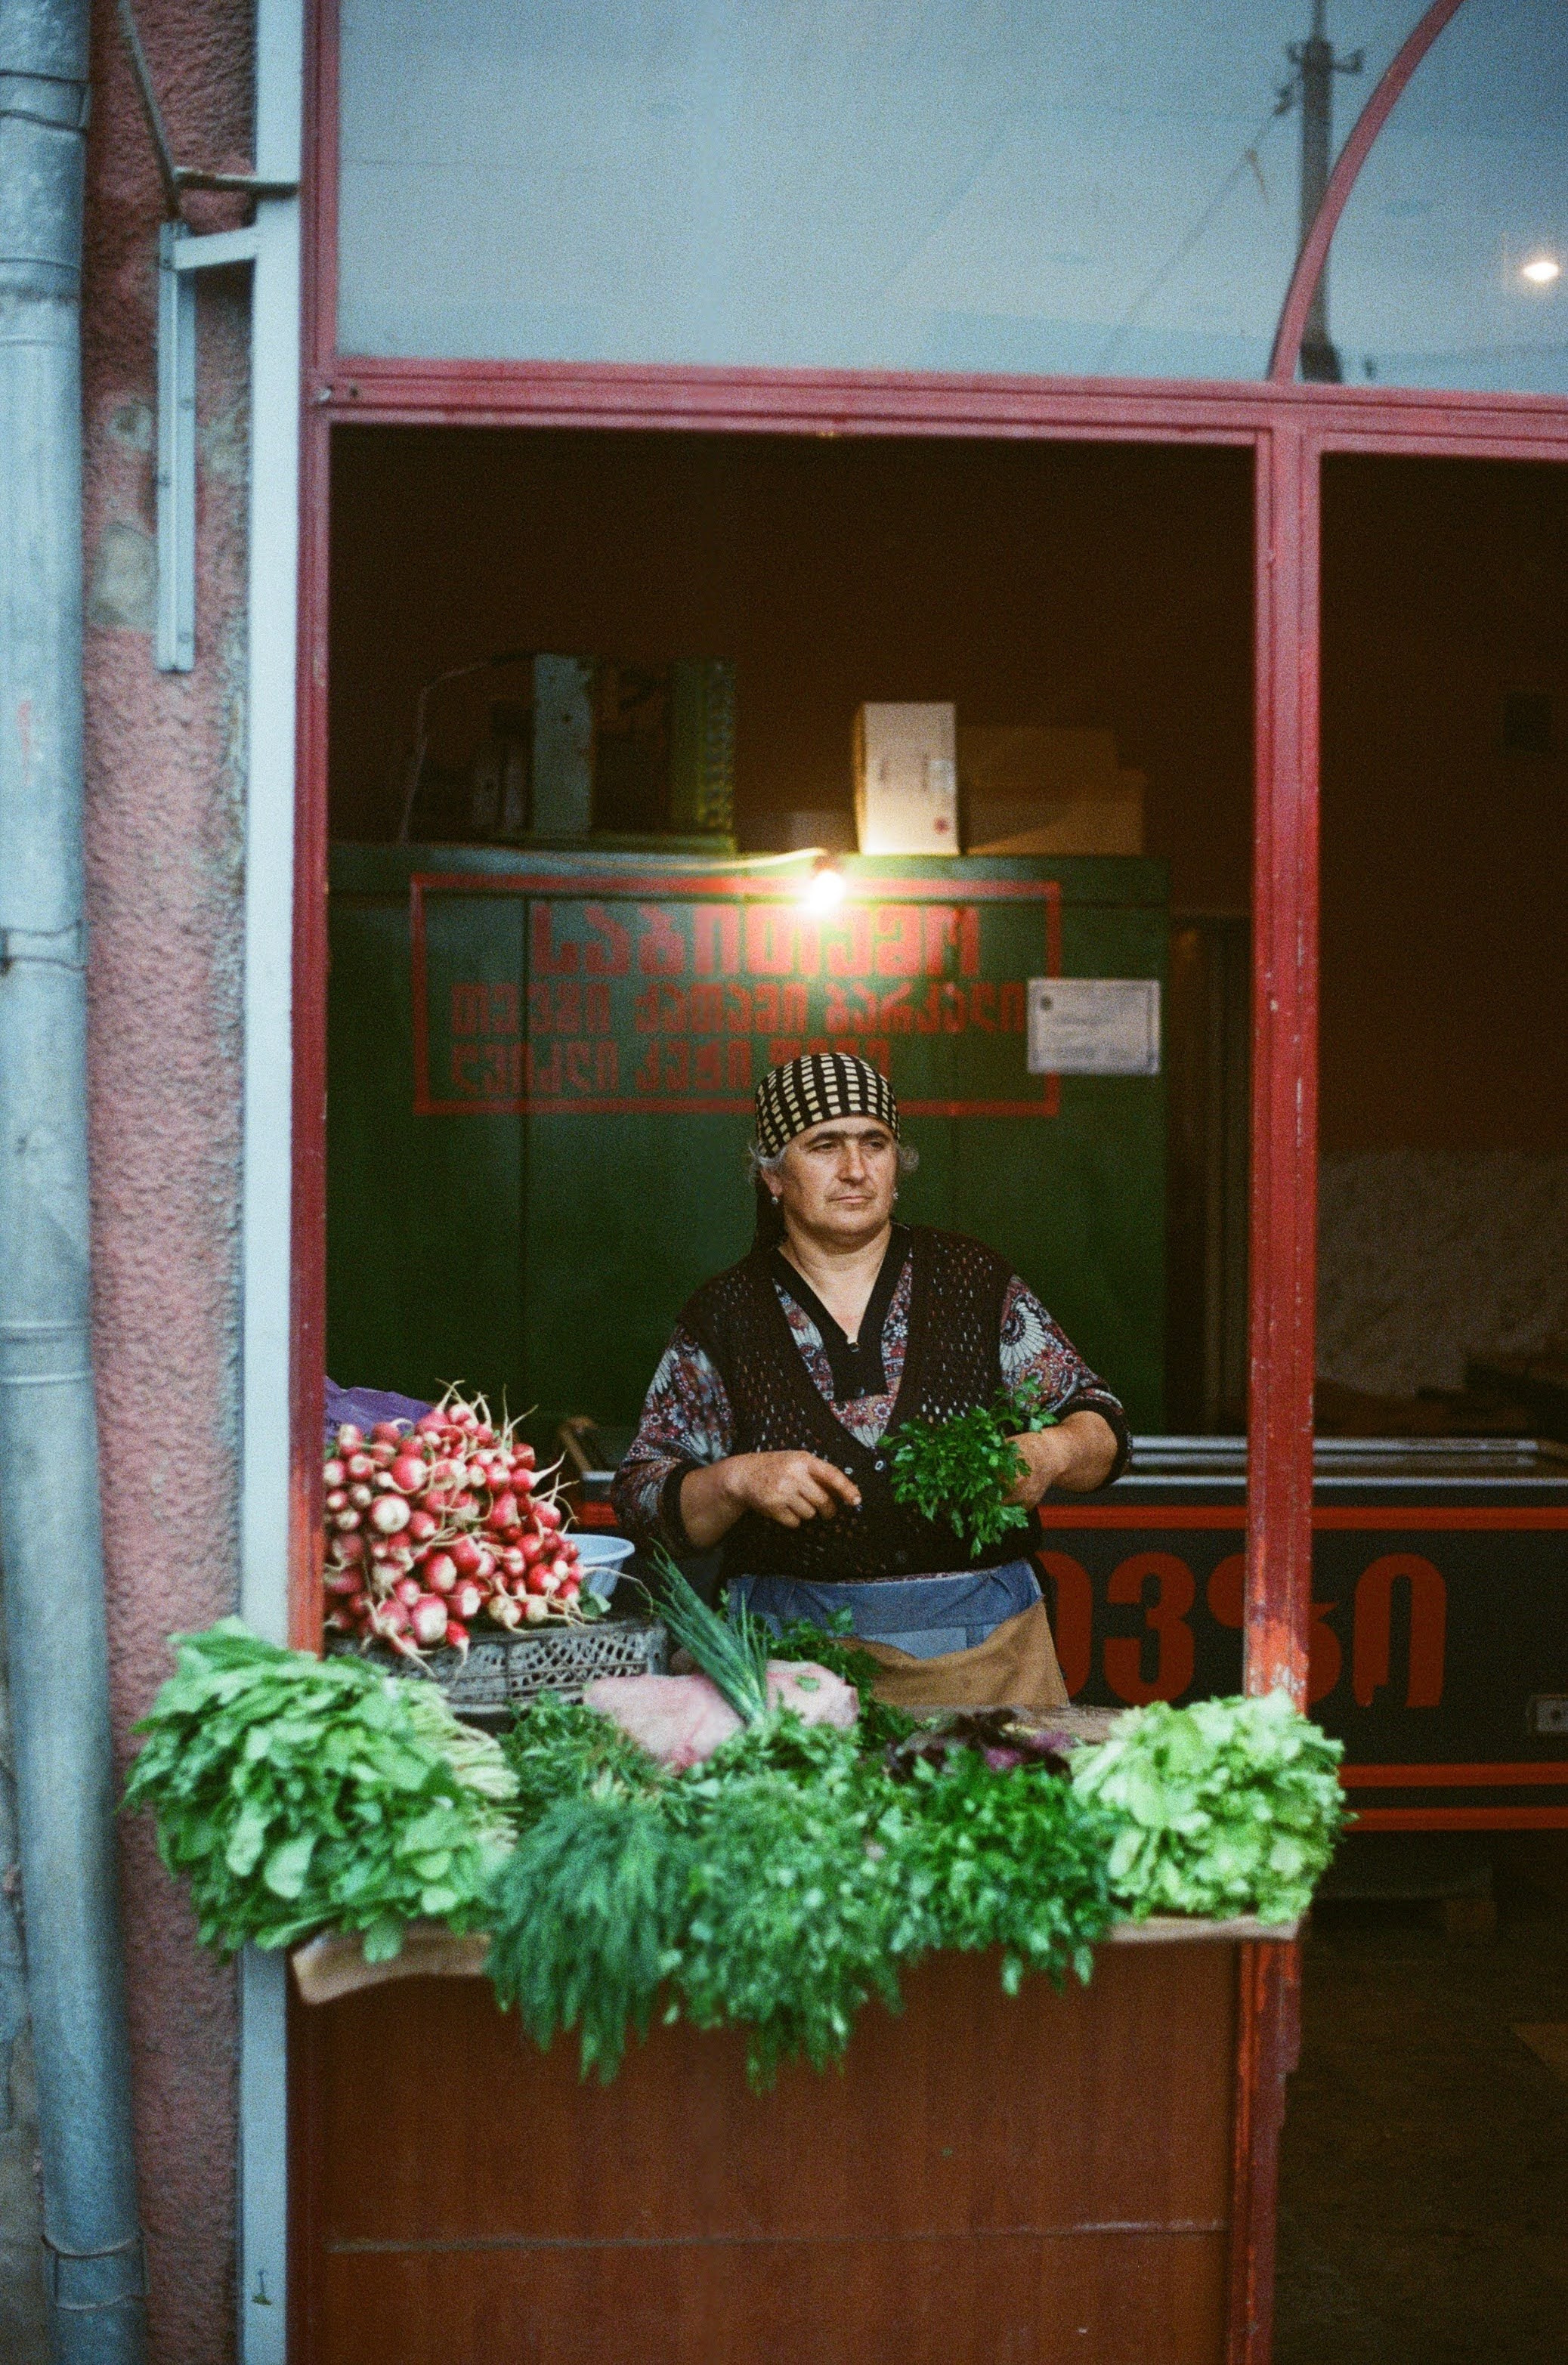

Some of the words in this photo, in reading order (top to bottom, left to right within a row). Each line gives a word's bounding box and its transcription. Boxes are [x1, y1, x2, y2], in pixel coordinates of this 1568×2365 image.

[533, 902, 979, 975] საბითუმო
[453, 982, 609, 1034] თევზი
[635, 982, 807, 1034] ქათამი
[825, 982, 1025, 1033] ბარკალი
[635, 1040, 752, 1091] კუჭი
